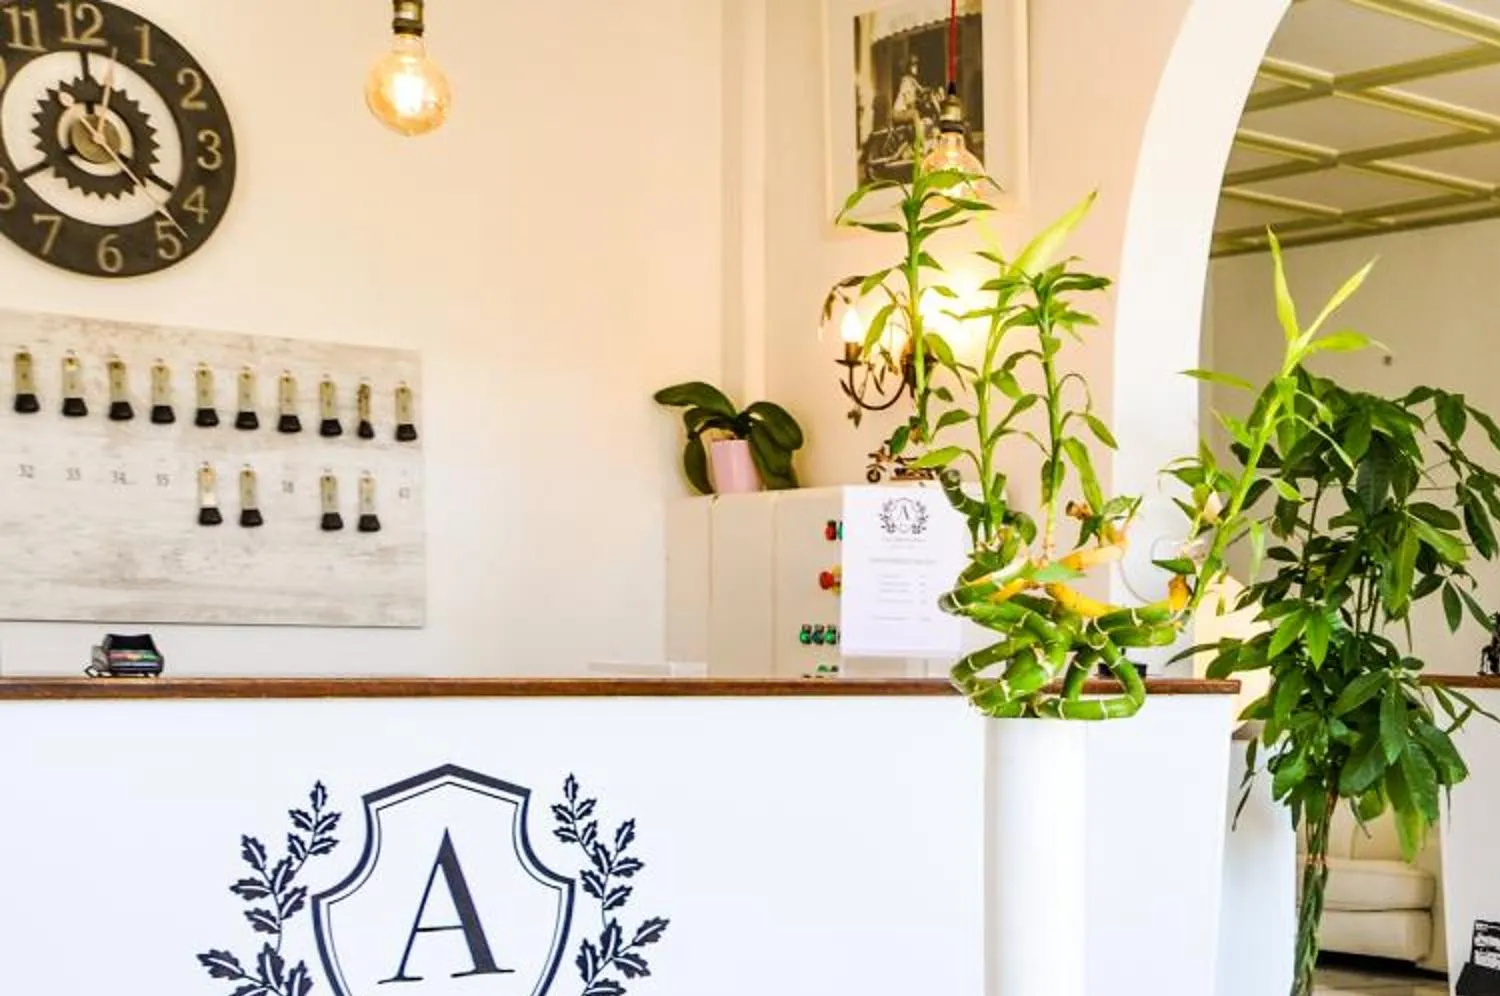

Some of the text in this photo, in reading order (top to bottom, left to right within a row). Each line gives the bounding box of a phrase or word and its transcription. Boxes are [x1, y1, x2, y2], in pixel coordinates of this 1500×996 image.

[3, 5, 48, 52] 11
[56, 2, 108, 47] 12
[133, 23, 158, 67] 1
[176, 67, 209, 111] 2
[196, 129, 223, 171] 3
[182, 185, 209, 225] 4
[32, 212, 63, 256] 7
[96, 233, 125, 274] 6
[154, 218, 183, 261] 5
[377, 826, 516, 985] A
